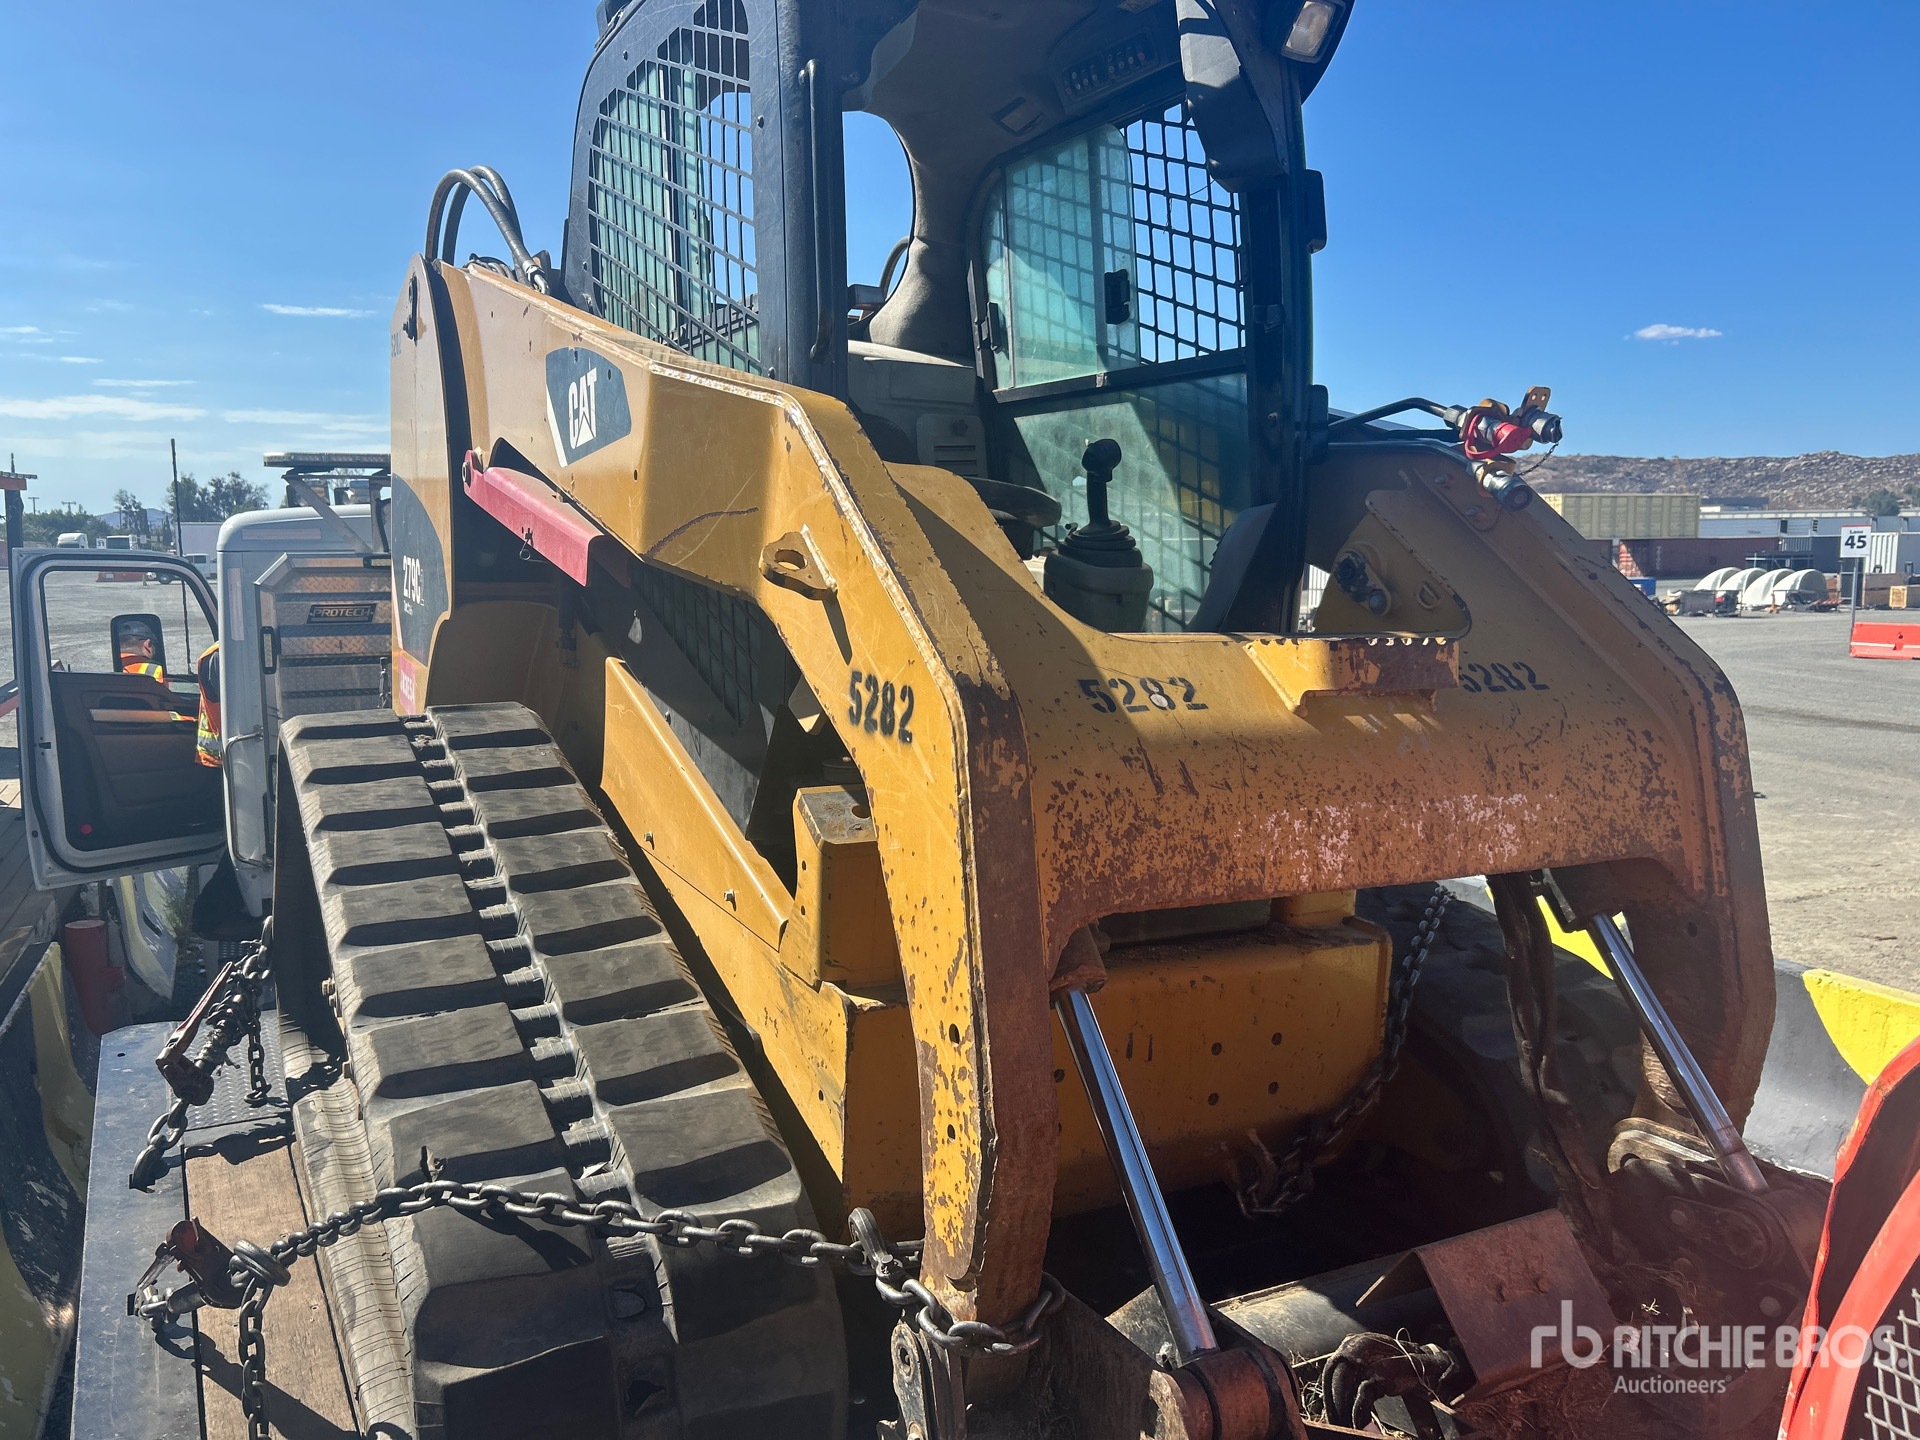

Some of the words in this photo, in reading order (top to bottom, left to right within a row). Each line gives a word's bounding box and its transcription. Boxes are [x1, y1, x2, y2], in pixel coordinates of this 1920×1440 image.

[568, 367, 598, 450] CAT
[1844, 535, 1867, 549] 45
[402, 555, 422, 604] 279C
[312, 608, 370, 617] PROTECH
[848, 670, 915, 744] 5282
[1077, 676, 1209, 714] 5282
